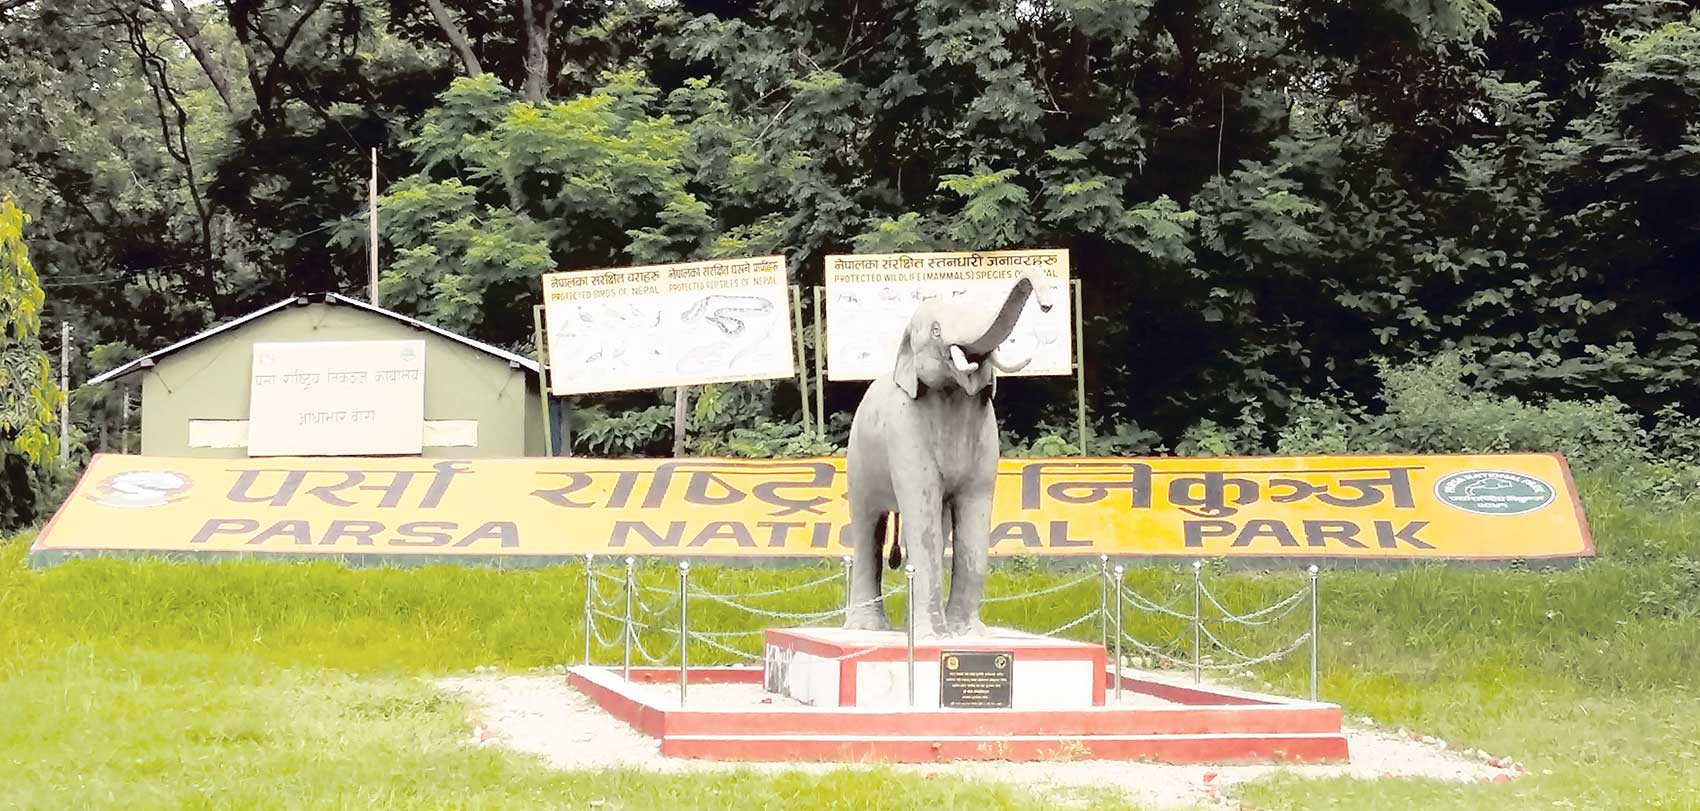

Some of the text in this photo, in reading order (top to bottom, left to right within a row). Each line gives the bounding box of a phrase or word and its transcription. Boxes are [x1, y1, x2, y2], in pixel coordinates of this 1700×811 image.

[928, 253, 984, 268] स्तनधारी
[753, 276, 777, 285] NEPAL
[834, 273, 882, 283] PROTECTED
[884, 272, 921, 282] WILDLIFE
[976, 270, 1012, 280] SPECIES
[631, 286, 660, 296] NEPAL
[225, 460, 475, 509] पर्सा
[190, 518, 1436, 550] PARSA NATIAL PARK
